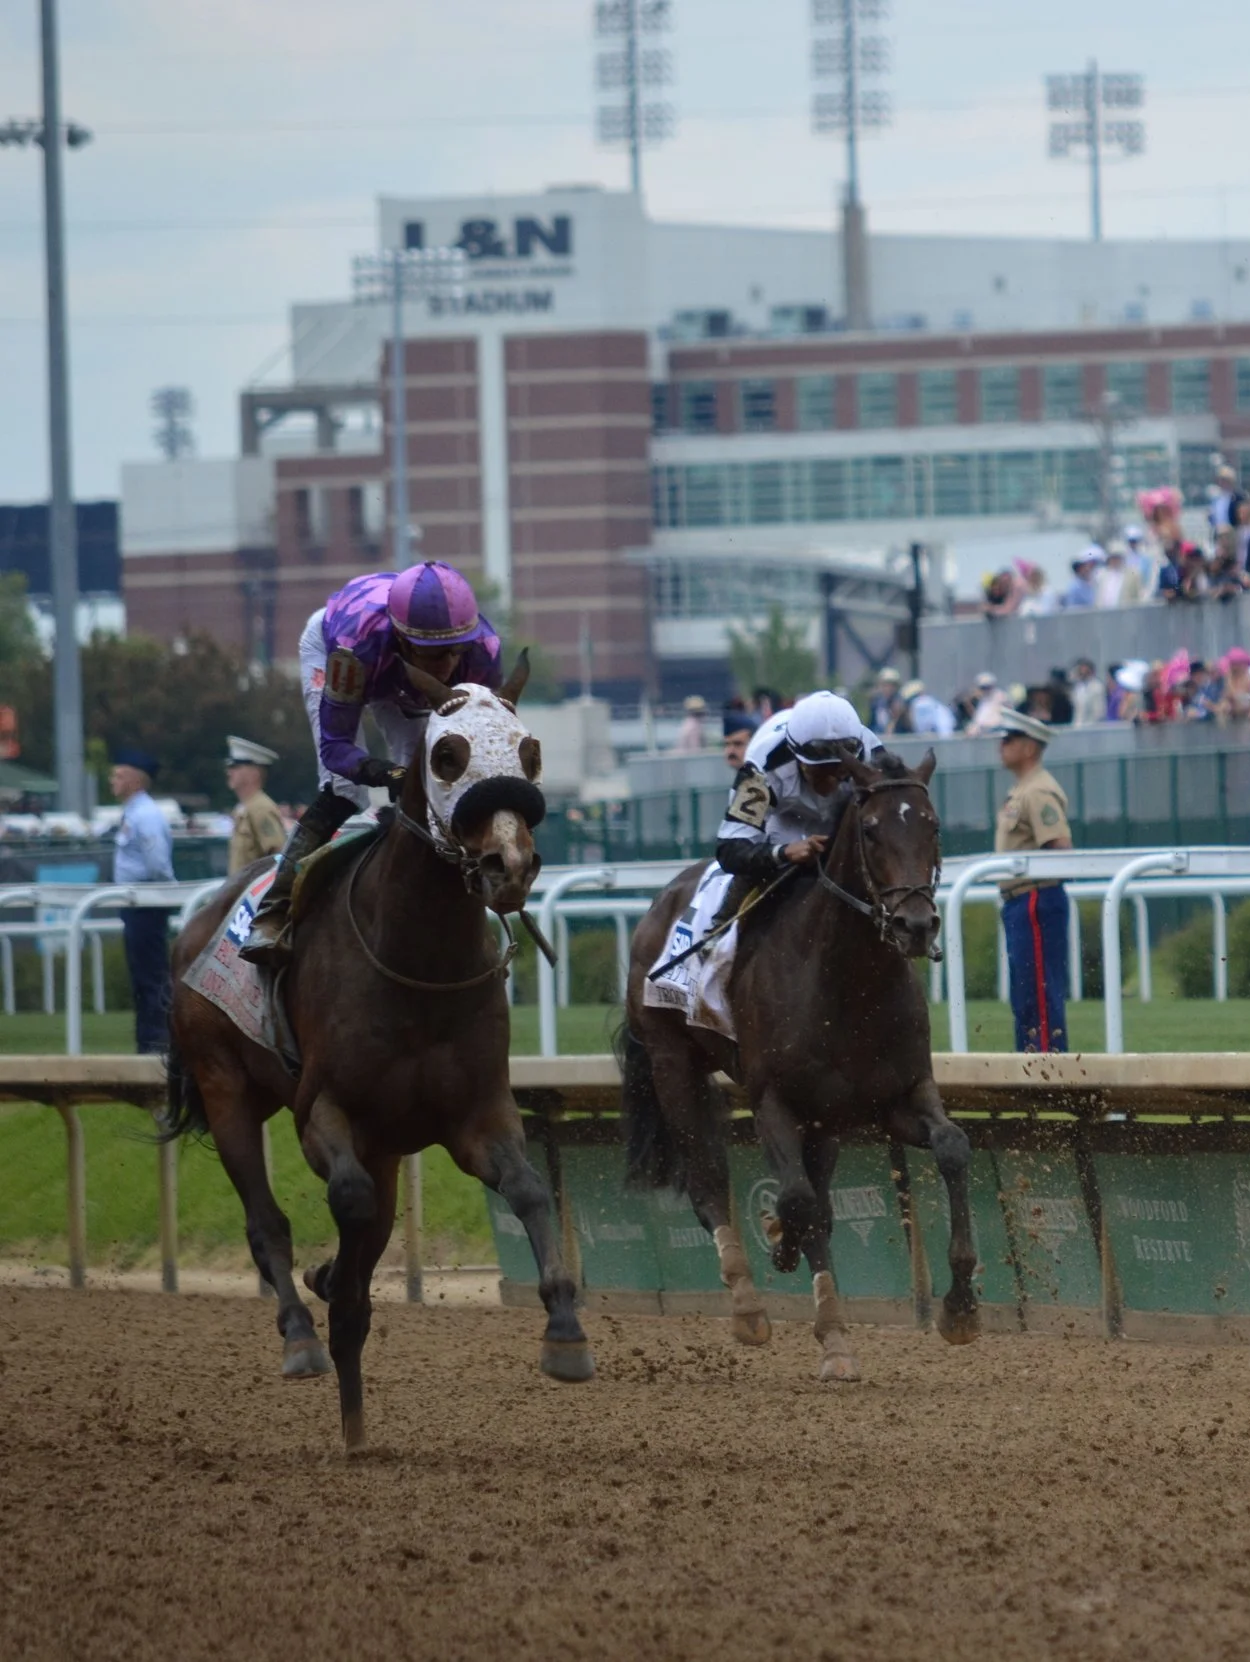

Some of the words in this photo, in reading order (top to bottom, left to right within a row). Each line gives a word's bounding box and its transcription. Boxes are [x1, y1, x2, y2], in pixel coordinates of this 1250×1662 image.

[331, 659, 357, 695] 11
[740, 786, 767, 817] 2
[1117, 1195, 1189, 1223] WOODFORD
[1133, 1234, 1194, 1263] RESERVE
